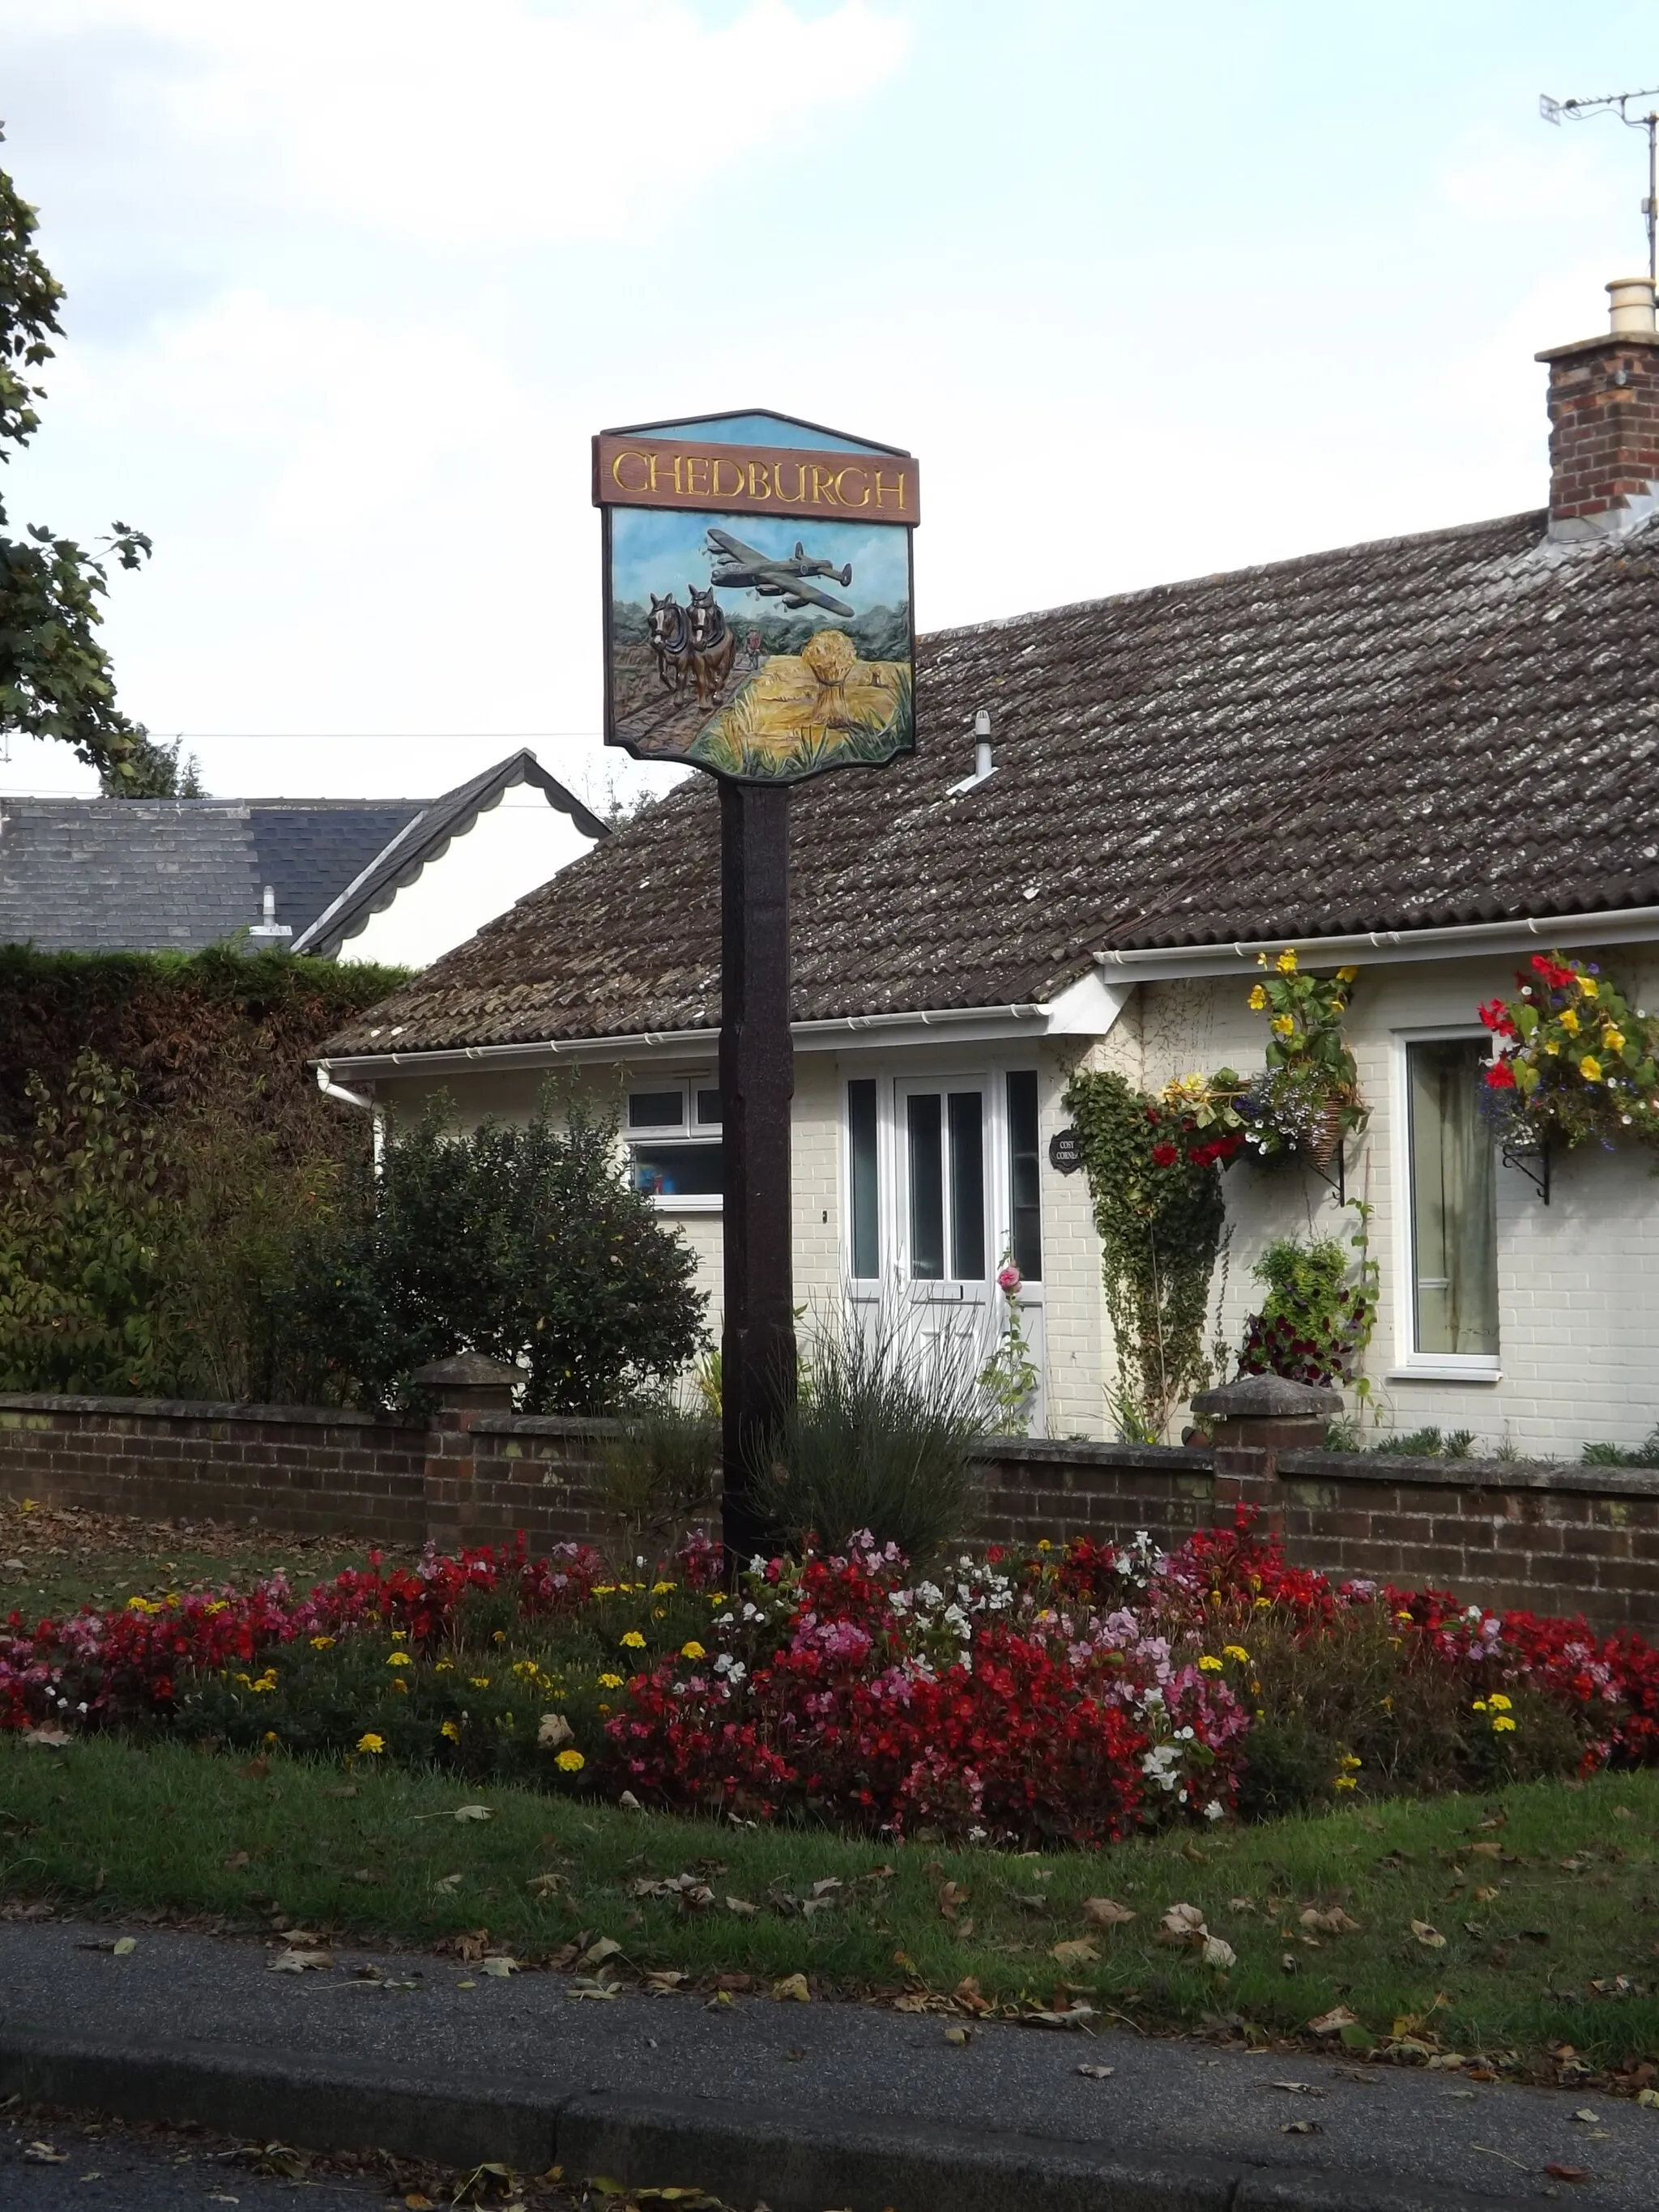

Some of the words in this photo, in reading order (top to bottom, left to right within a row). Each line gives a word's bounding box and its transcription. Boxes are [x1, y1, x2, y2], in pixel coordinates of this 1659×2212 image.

[612, 451, 906, 509] CHEDBURGH
[1060, 1140, 1075, 1149] COSY
[1056, 1151, 1078, 1160] CORNE
